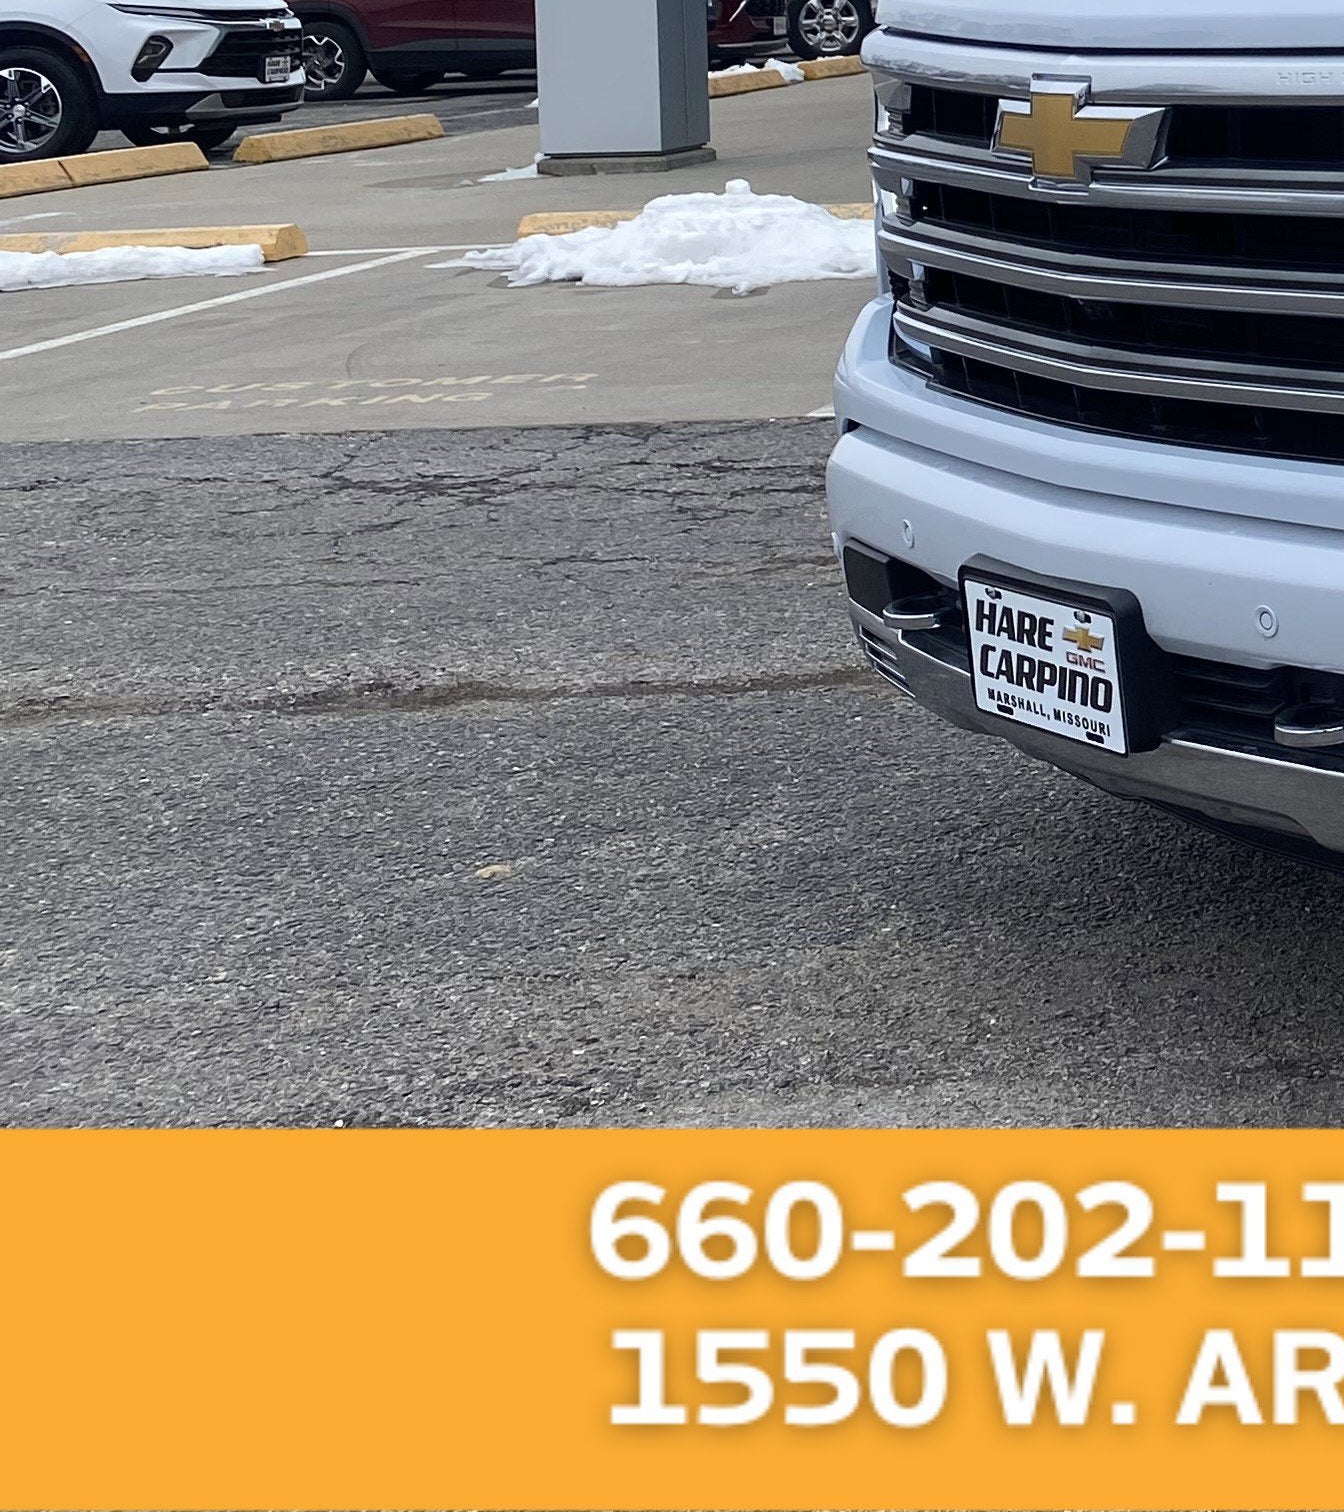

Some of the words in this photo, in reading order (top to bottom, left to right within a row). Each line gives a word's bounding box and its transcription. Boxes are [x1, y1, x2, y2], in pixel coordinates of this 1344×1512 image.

[1277, 71, 1333, 86] HIGH
[150, 373, 599, 396] CUSTOMER
[130, 392, 494, 415] PARKING
[975, 598, 1055, 653] HARE
[1065, 650, 1106, 674] GMC
[979, 643, 1114, 714] CARPINO
[987, 686, 1051, 721] MARSHALL,
[1053, 707, 1111, 738] MISSOURI
